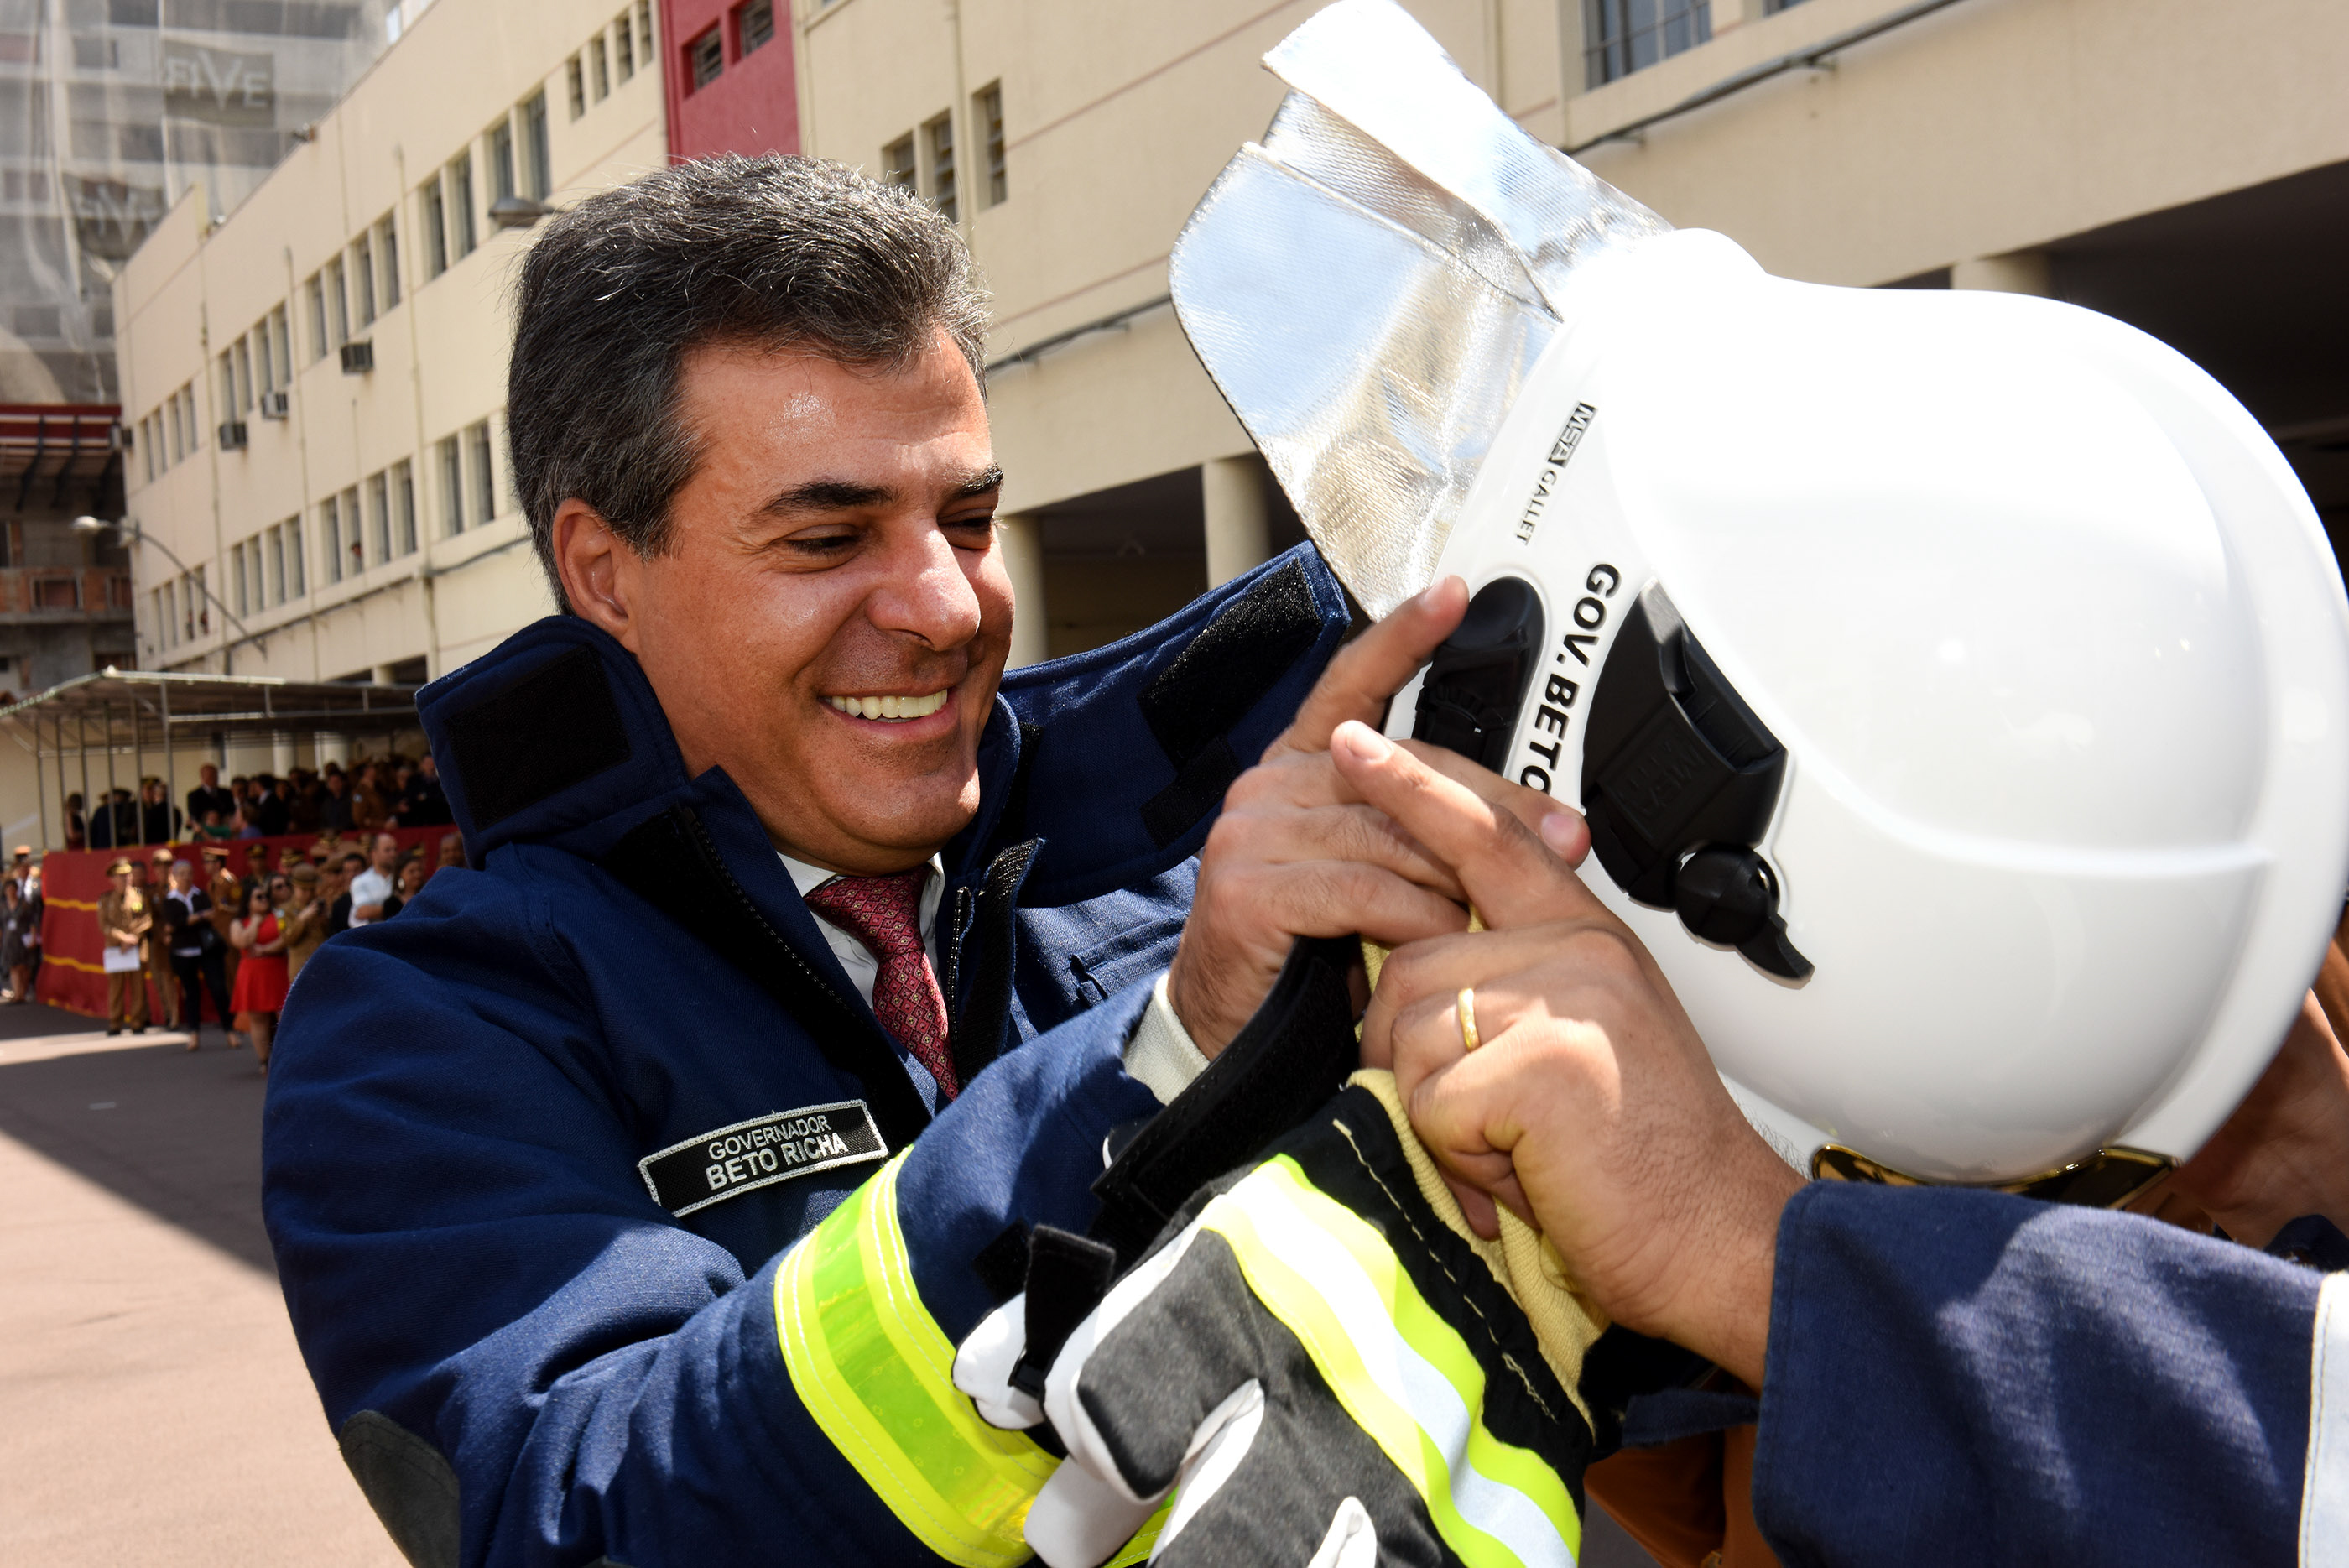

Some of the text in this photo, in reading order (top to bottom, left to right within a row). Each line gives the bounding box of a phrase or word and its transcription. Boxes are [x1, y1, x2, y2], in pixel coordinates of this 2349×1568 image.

[167, 49, 268, 110] FIVE
[1516, 403, 1596, 545] MSA GALLET
[1520, 563, 1621, 795] GOV. BETO
[705, 1133, 849, 1191] BETO RICHA
[708, 1114, 831, 1161] GOVERNADOR
